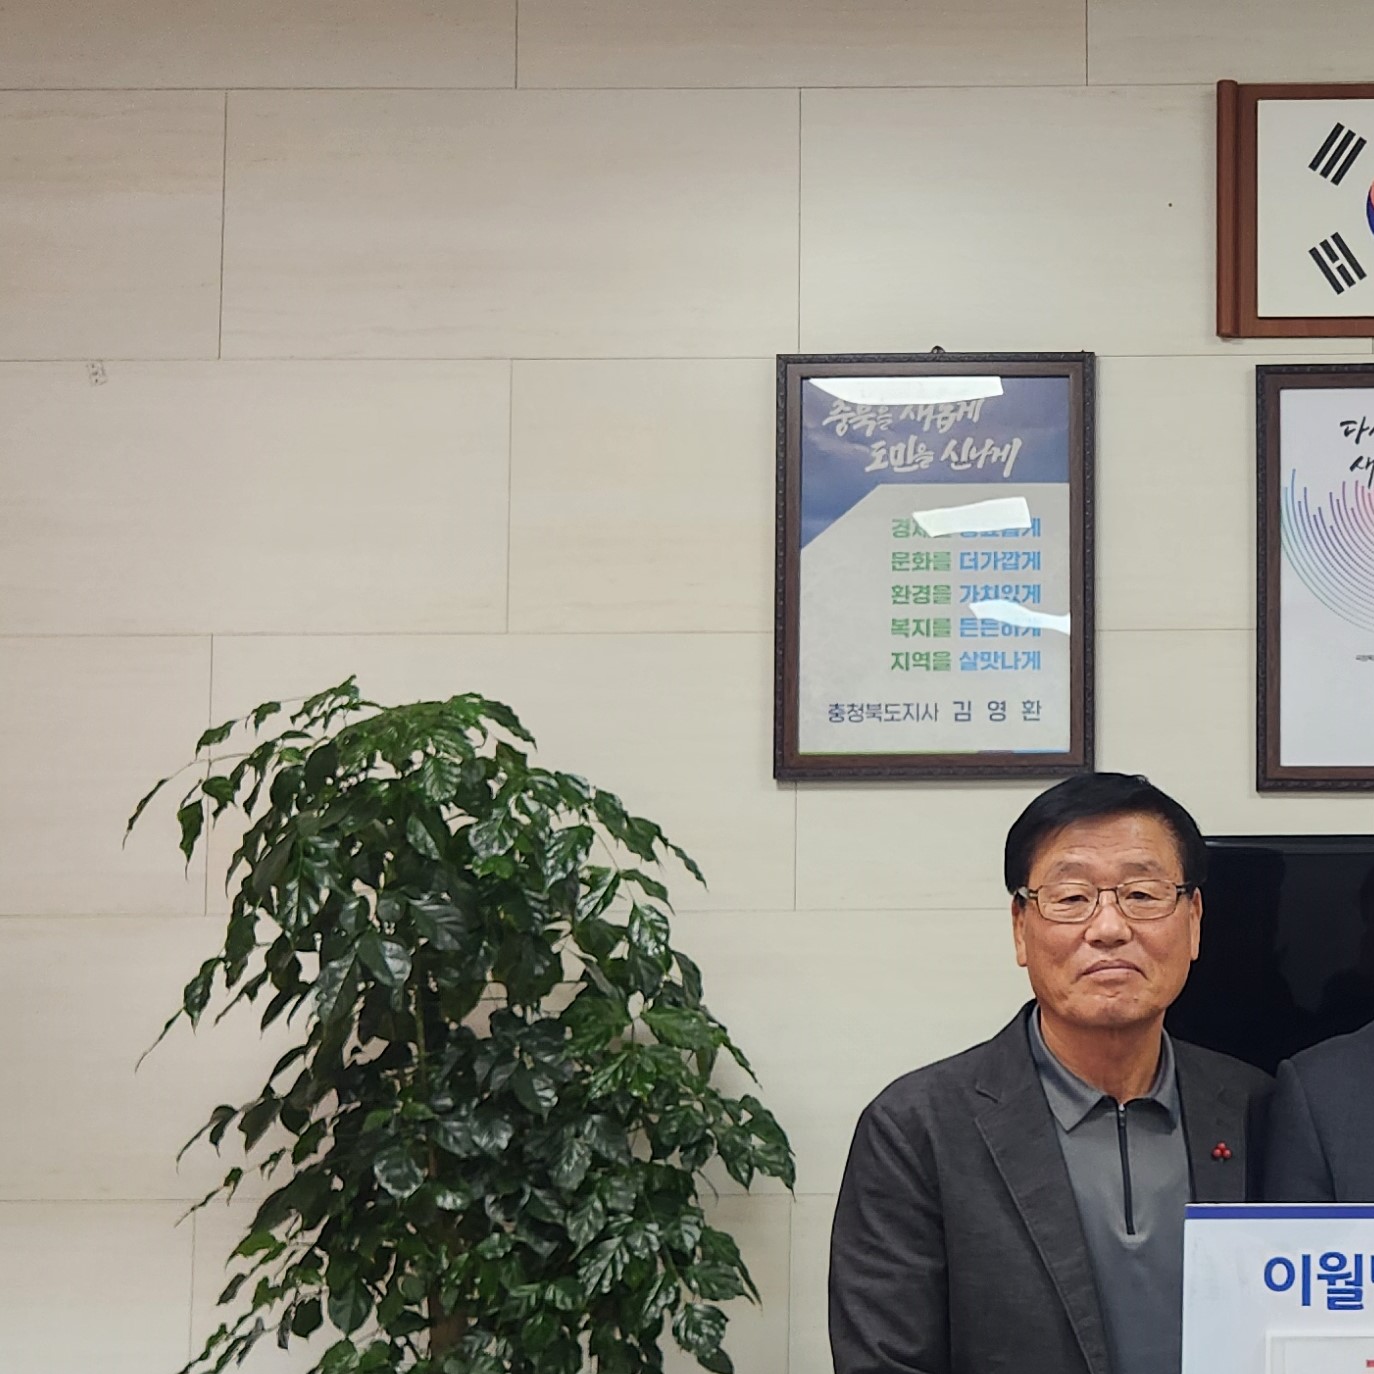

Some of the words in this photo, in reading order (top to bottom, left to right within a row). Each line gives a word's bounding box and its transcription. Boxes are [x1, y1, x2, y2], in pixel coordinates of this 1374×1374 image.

[865, 435, 934, 472] 도민을
[941, 437, 1022, 478] 신나게
[891, 551, 951, 571] 문화를
[959, 551, 1042, 571] 더가깝게
[891, 584, 951, 605] 환경을
[959, 584, 1042, 604] 가치있게
[891, 618, 951, 638] 복지를
[891, 651, 951, 671] 지역을
[959, 651, 1042, 671] 살맛나게
[828, 702, 938, 723] 충청북도지사
